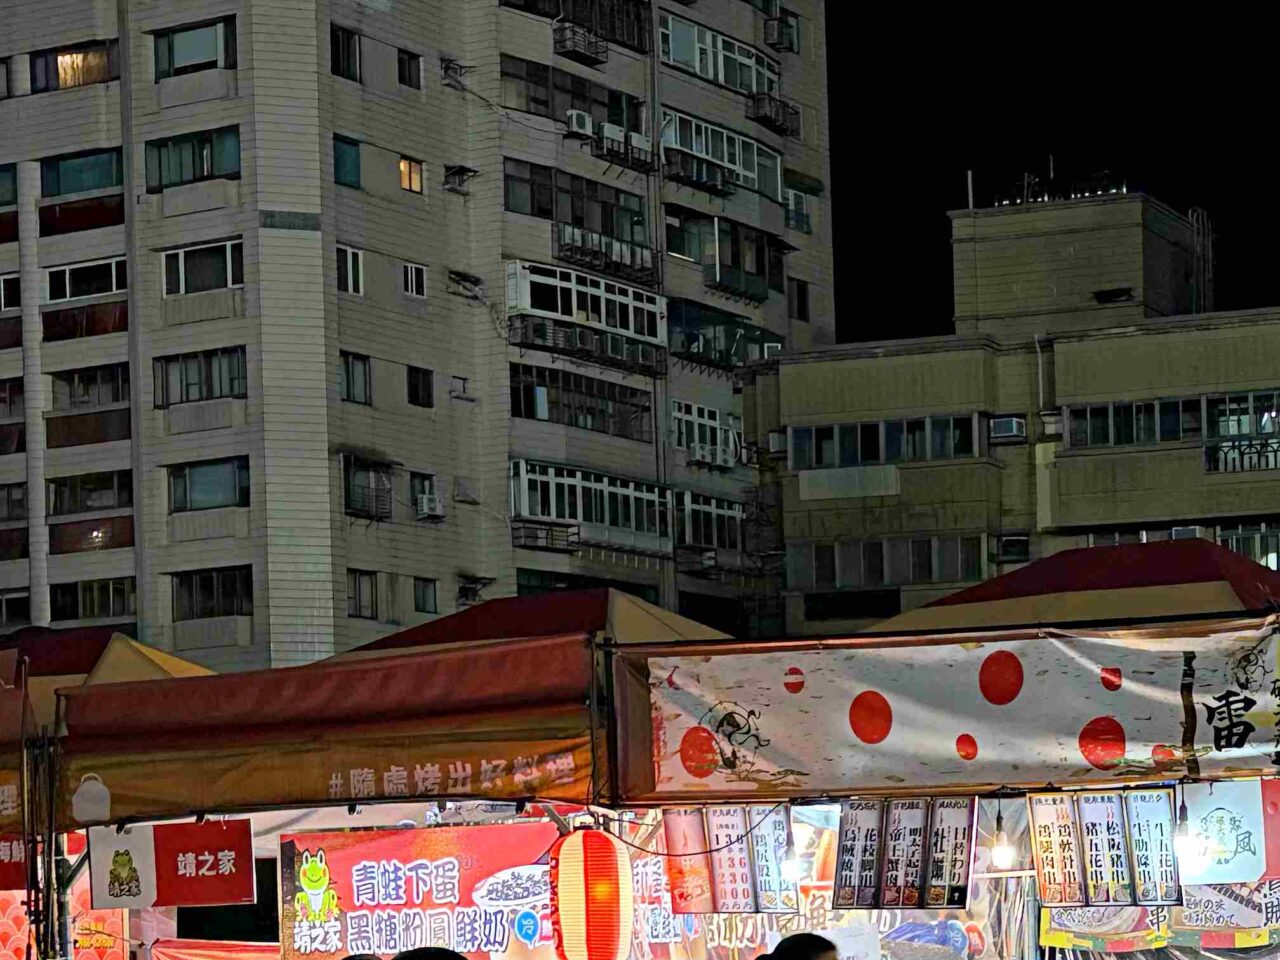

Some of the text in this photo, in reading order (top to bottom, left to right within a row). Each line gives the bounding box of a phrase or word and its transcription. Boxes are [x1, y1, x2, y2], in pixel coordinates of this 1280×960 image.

[1201, 690, 1257, 751] 雷
[176, 849, 236, 878] 靖之家
[351, 857, 462, 906] 青蛙下蛋
